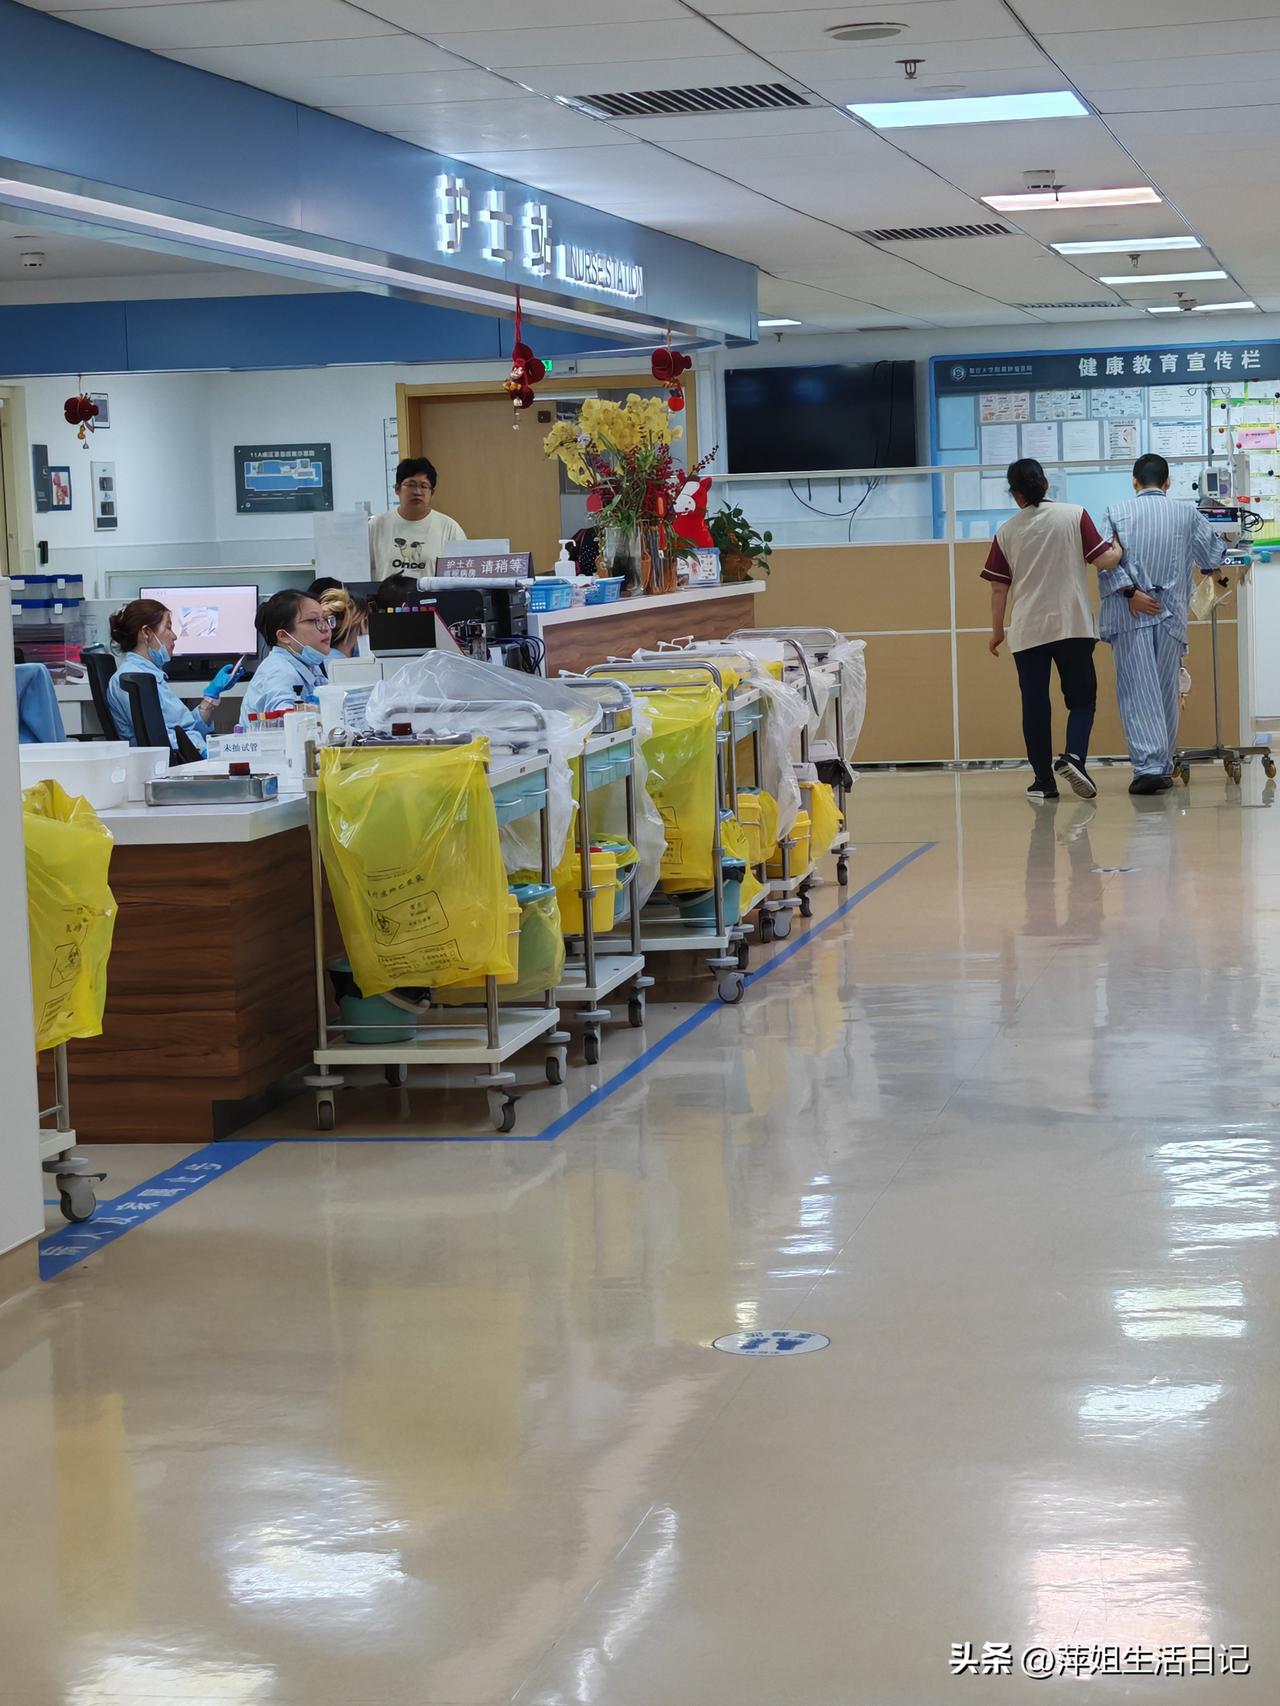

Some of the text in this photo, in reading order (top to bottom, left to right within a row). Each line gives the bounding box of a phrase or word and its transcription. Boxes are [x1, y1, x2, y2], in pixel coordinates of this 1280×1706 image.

[434, 172, 553, 276] 护士站
[570, 243, 606, 287] NURSE
[1078, 349, 1263, 378] 健康教育宣传栏
[391, 558, 426, 570] Once
[446, 557, 523, 575] 护士在 请稍等
[223, 742, 258, 753] 未抽试管
[40, 1162, 224, 1257] 病人及家属止步
